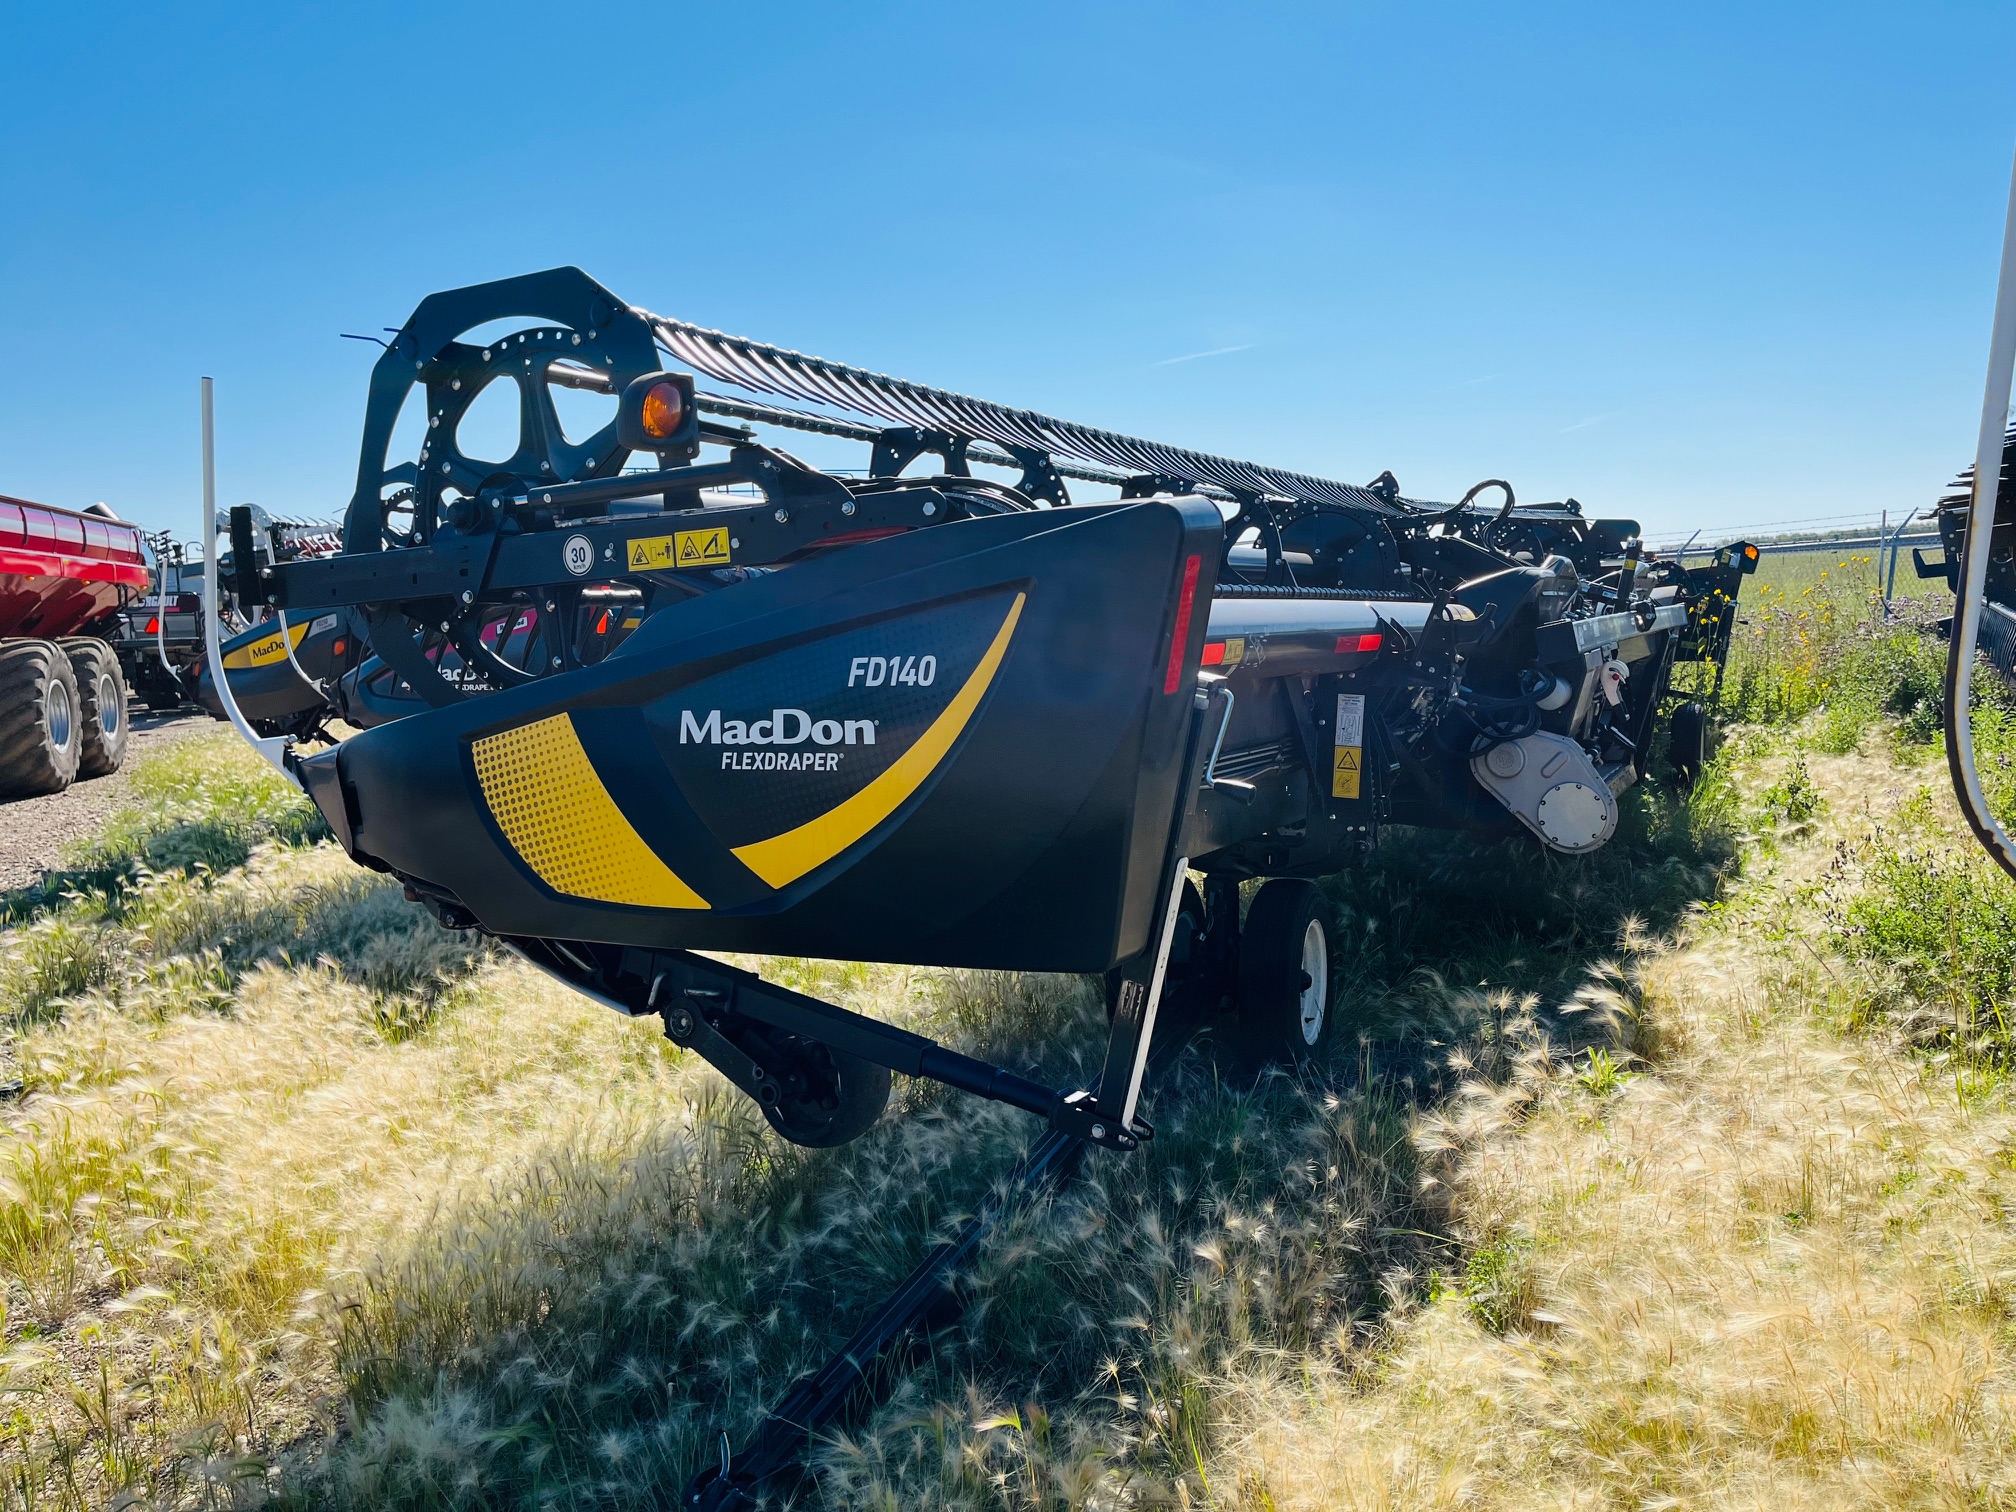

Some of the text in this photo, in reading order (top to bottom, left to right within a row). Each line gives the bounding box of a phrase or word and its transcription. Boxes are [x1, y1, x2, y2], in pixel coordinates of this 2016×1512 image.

[571, 546, 586, 564] 30
[252, 641, 285, 659] MacDo
[848, 655, 937, 687] FD140
[680, 709, 877, 745] MacDon
[721, 752, 839, 771] FLEXDRAPER
